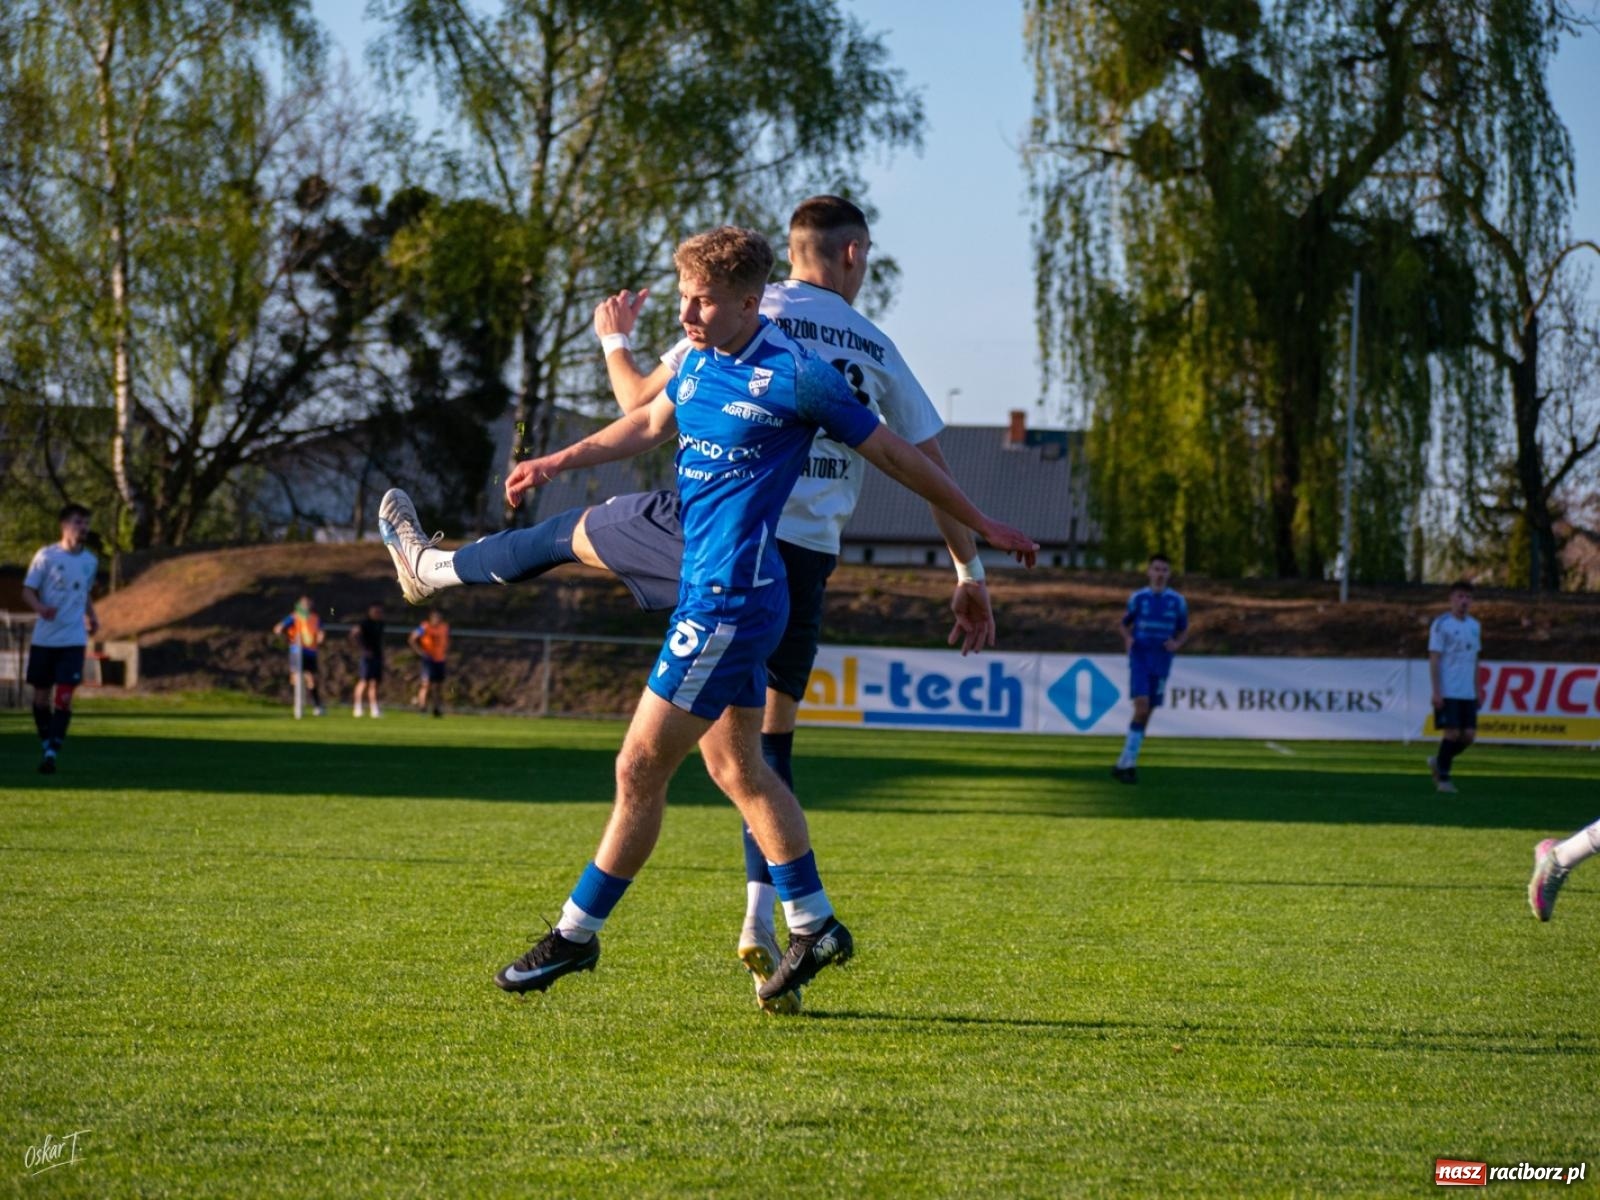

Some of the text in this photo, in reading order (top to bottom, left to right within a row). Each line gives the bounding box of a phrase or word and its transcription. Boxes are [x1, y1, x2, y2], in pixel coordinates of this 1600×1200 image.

[775, 316, 818, 342] PRZÓD
[721, 403, 783, 428] AGROTEAM
[804, 656, 1022, 714] al-tech
[1477, 665, 1600, 714] RIC
[1171, 687, 1384, 713] PRA BROKERS
